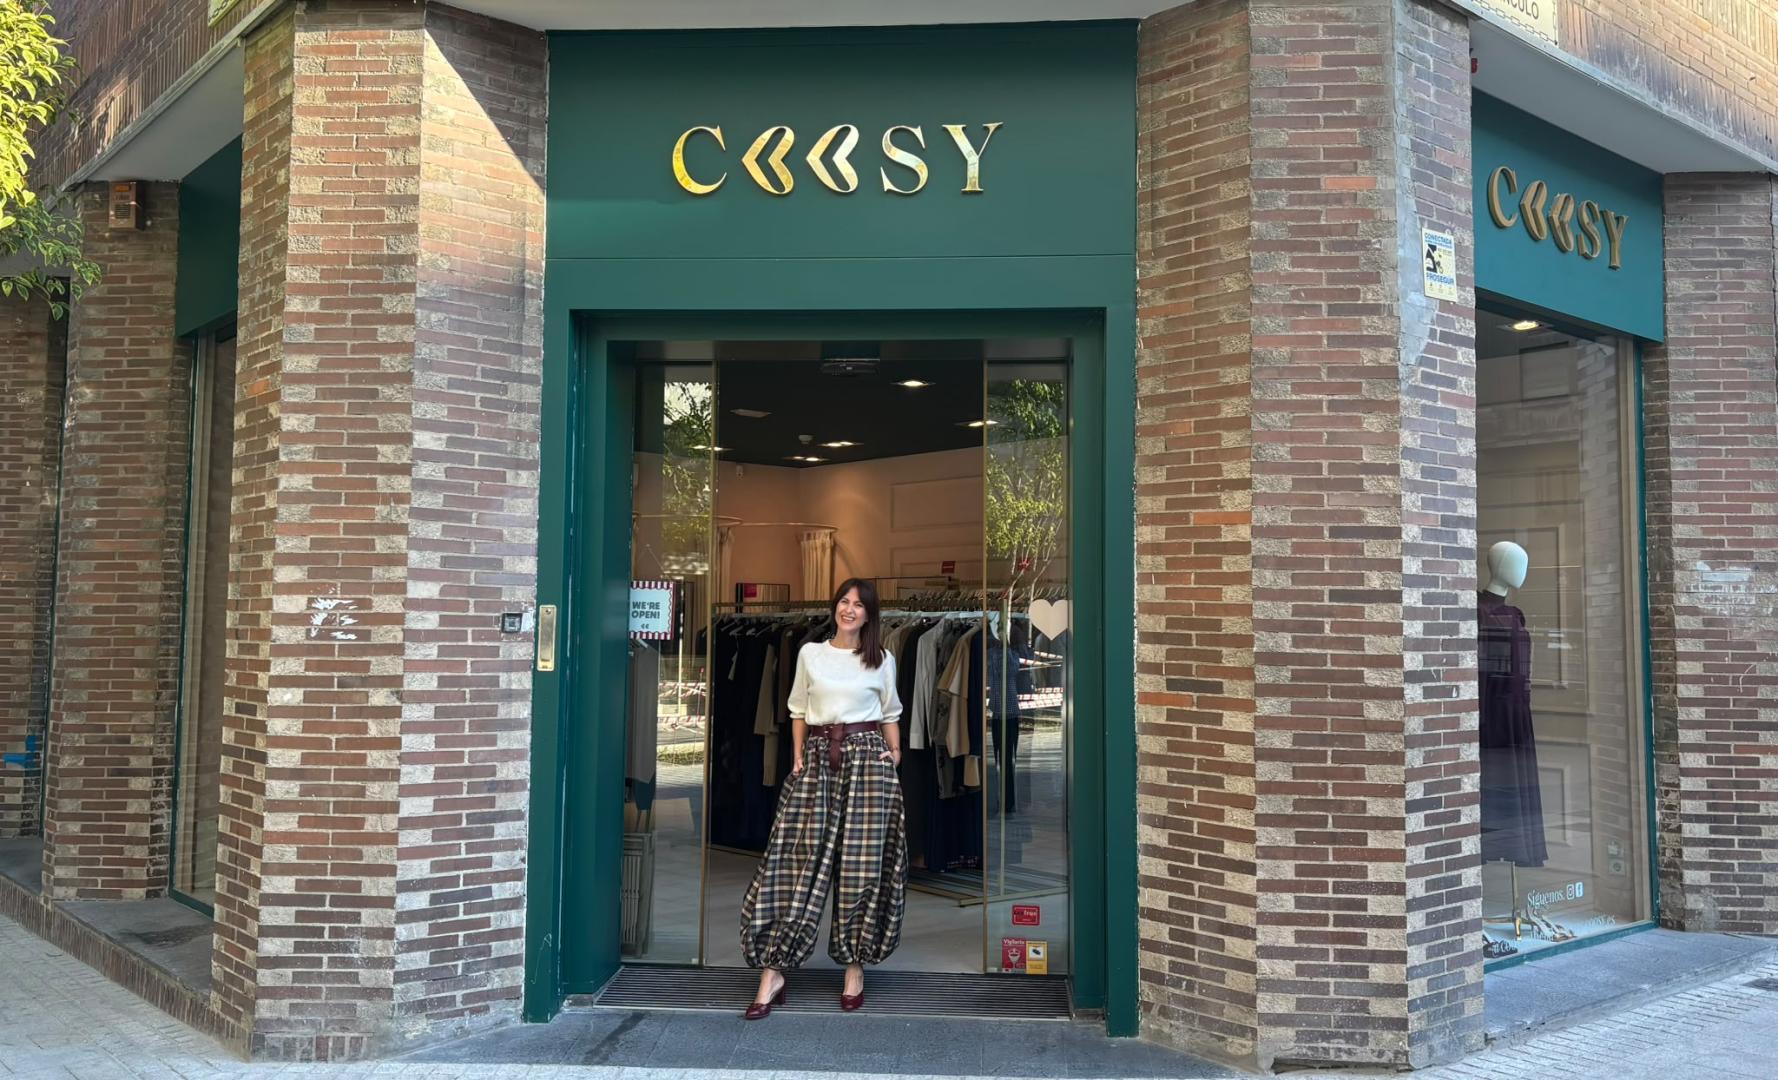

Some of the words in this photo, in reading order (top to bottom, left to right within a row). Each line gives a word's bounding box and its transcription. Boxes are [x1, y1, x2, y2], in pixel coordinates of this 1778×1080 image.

[1503, 0, 1539, 19] CULO
[632, 601, 660, 610] WE'RE
[631, 610, 661, 619] OPEN!
